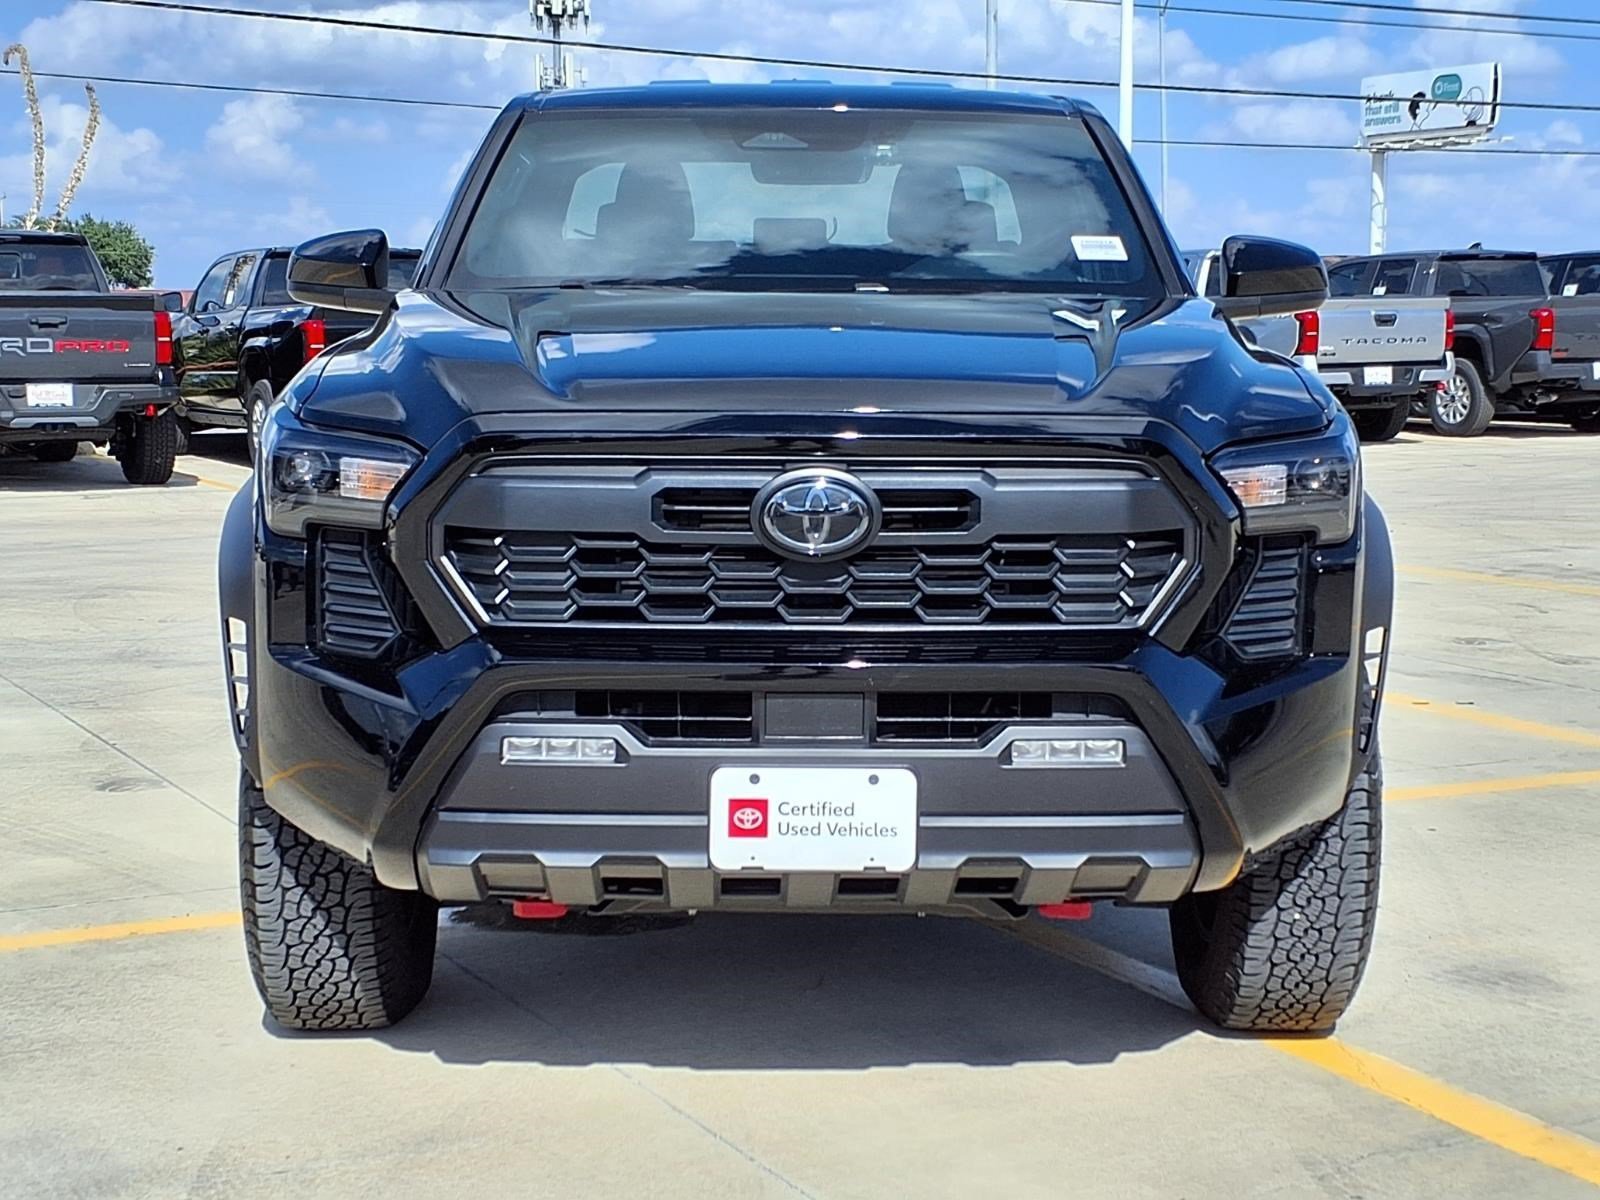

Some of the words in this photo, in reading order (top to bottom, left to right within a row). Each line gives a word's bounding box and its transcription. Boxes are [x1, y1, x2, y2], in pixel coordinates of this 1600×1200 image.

[54, 338, 130, 354] PRO
[1341, 337, 1429, 345] TACOMA
[778, 801, 855, 816] Certified
[778, 822, 821, 836] Used
[827, 822, 898, 838] Vehicles
